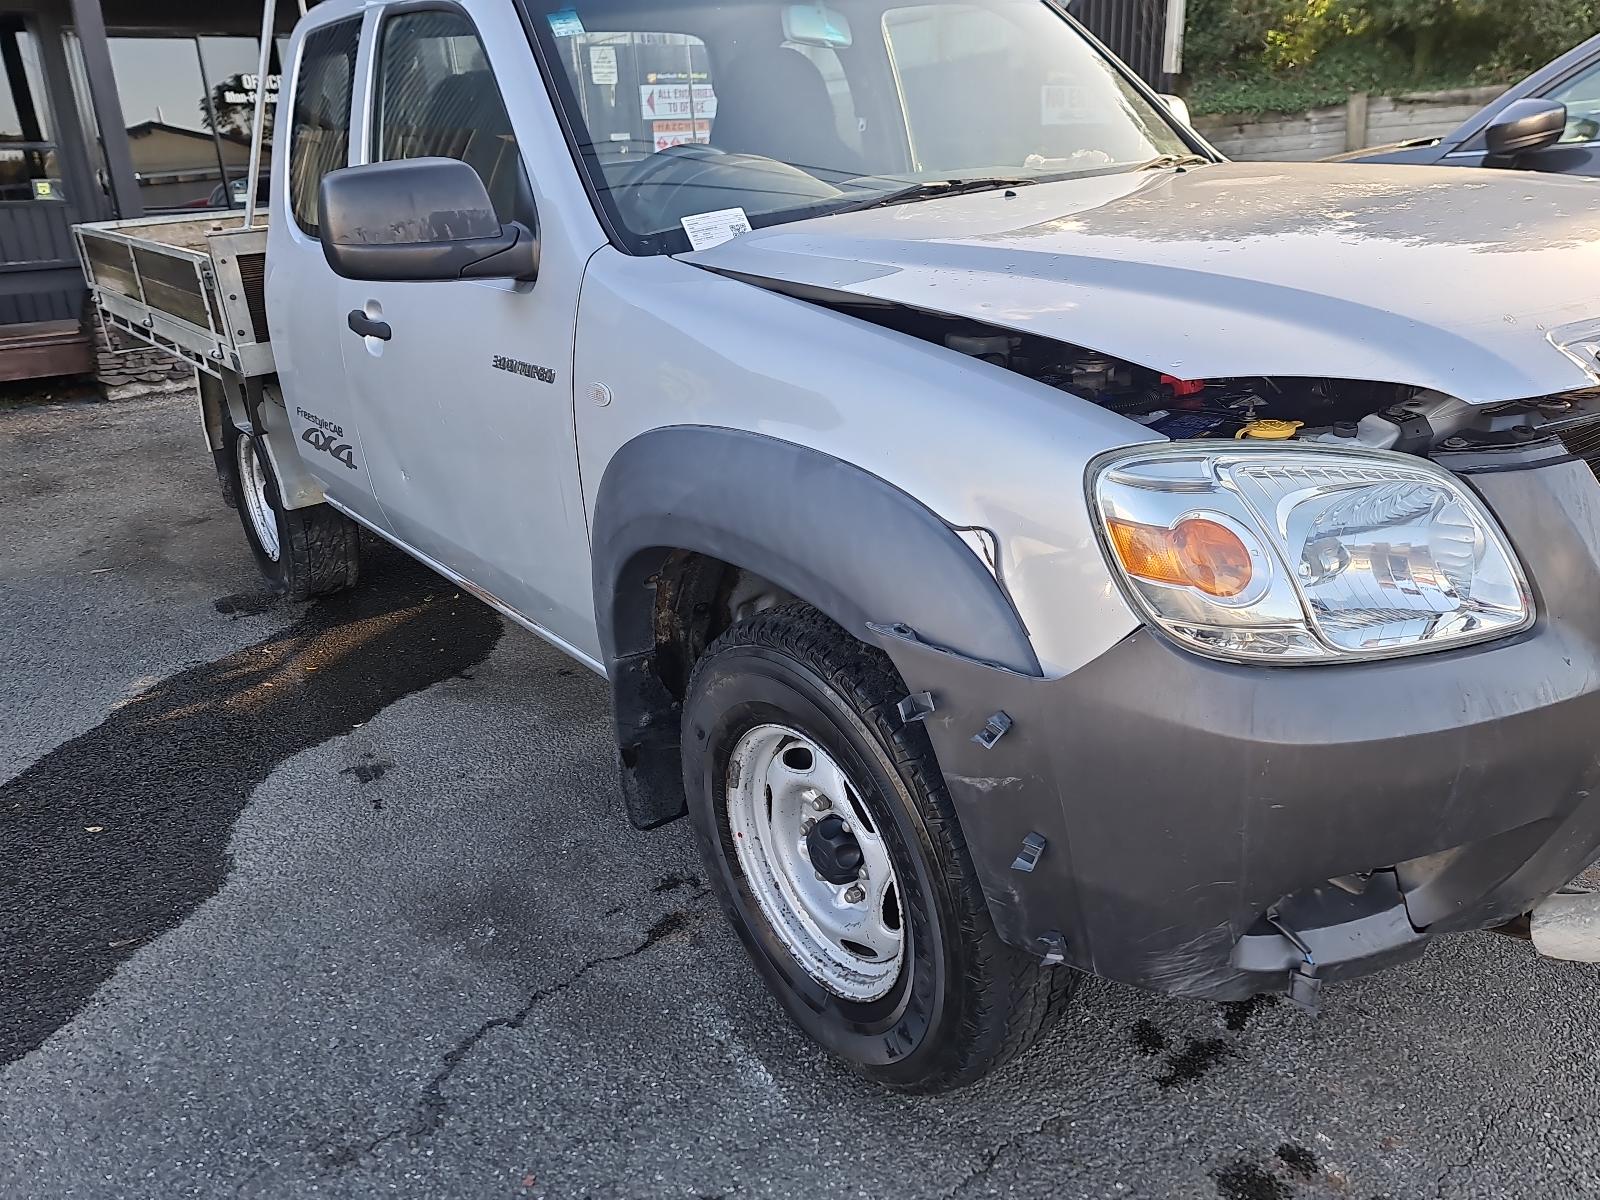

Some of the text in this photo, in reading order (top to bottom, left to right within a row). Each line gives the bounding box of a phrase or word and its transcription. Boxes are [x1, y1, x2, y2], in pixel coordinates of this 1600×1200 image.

[658, 89, 671, 98] ALL
[669, 102, 704, 112] TO OFICE
